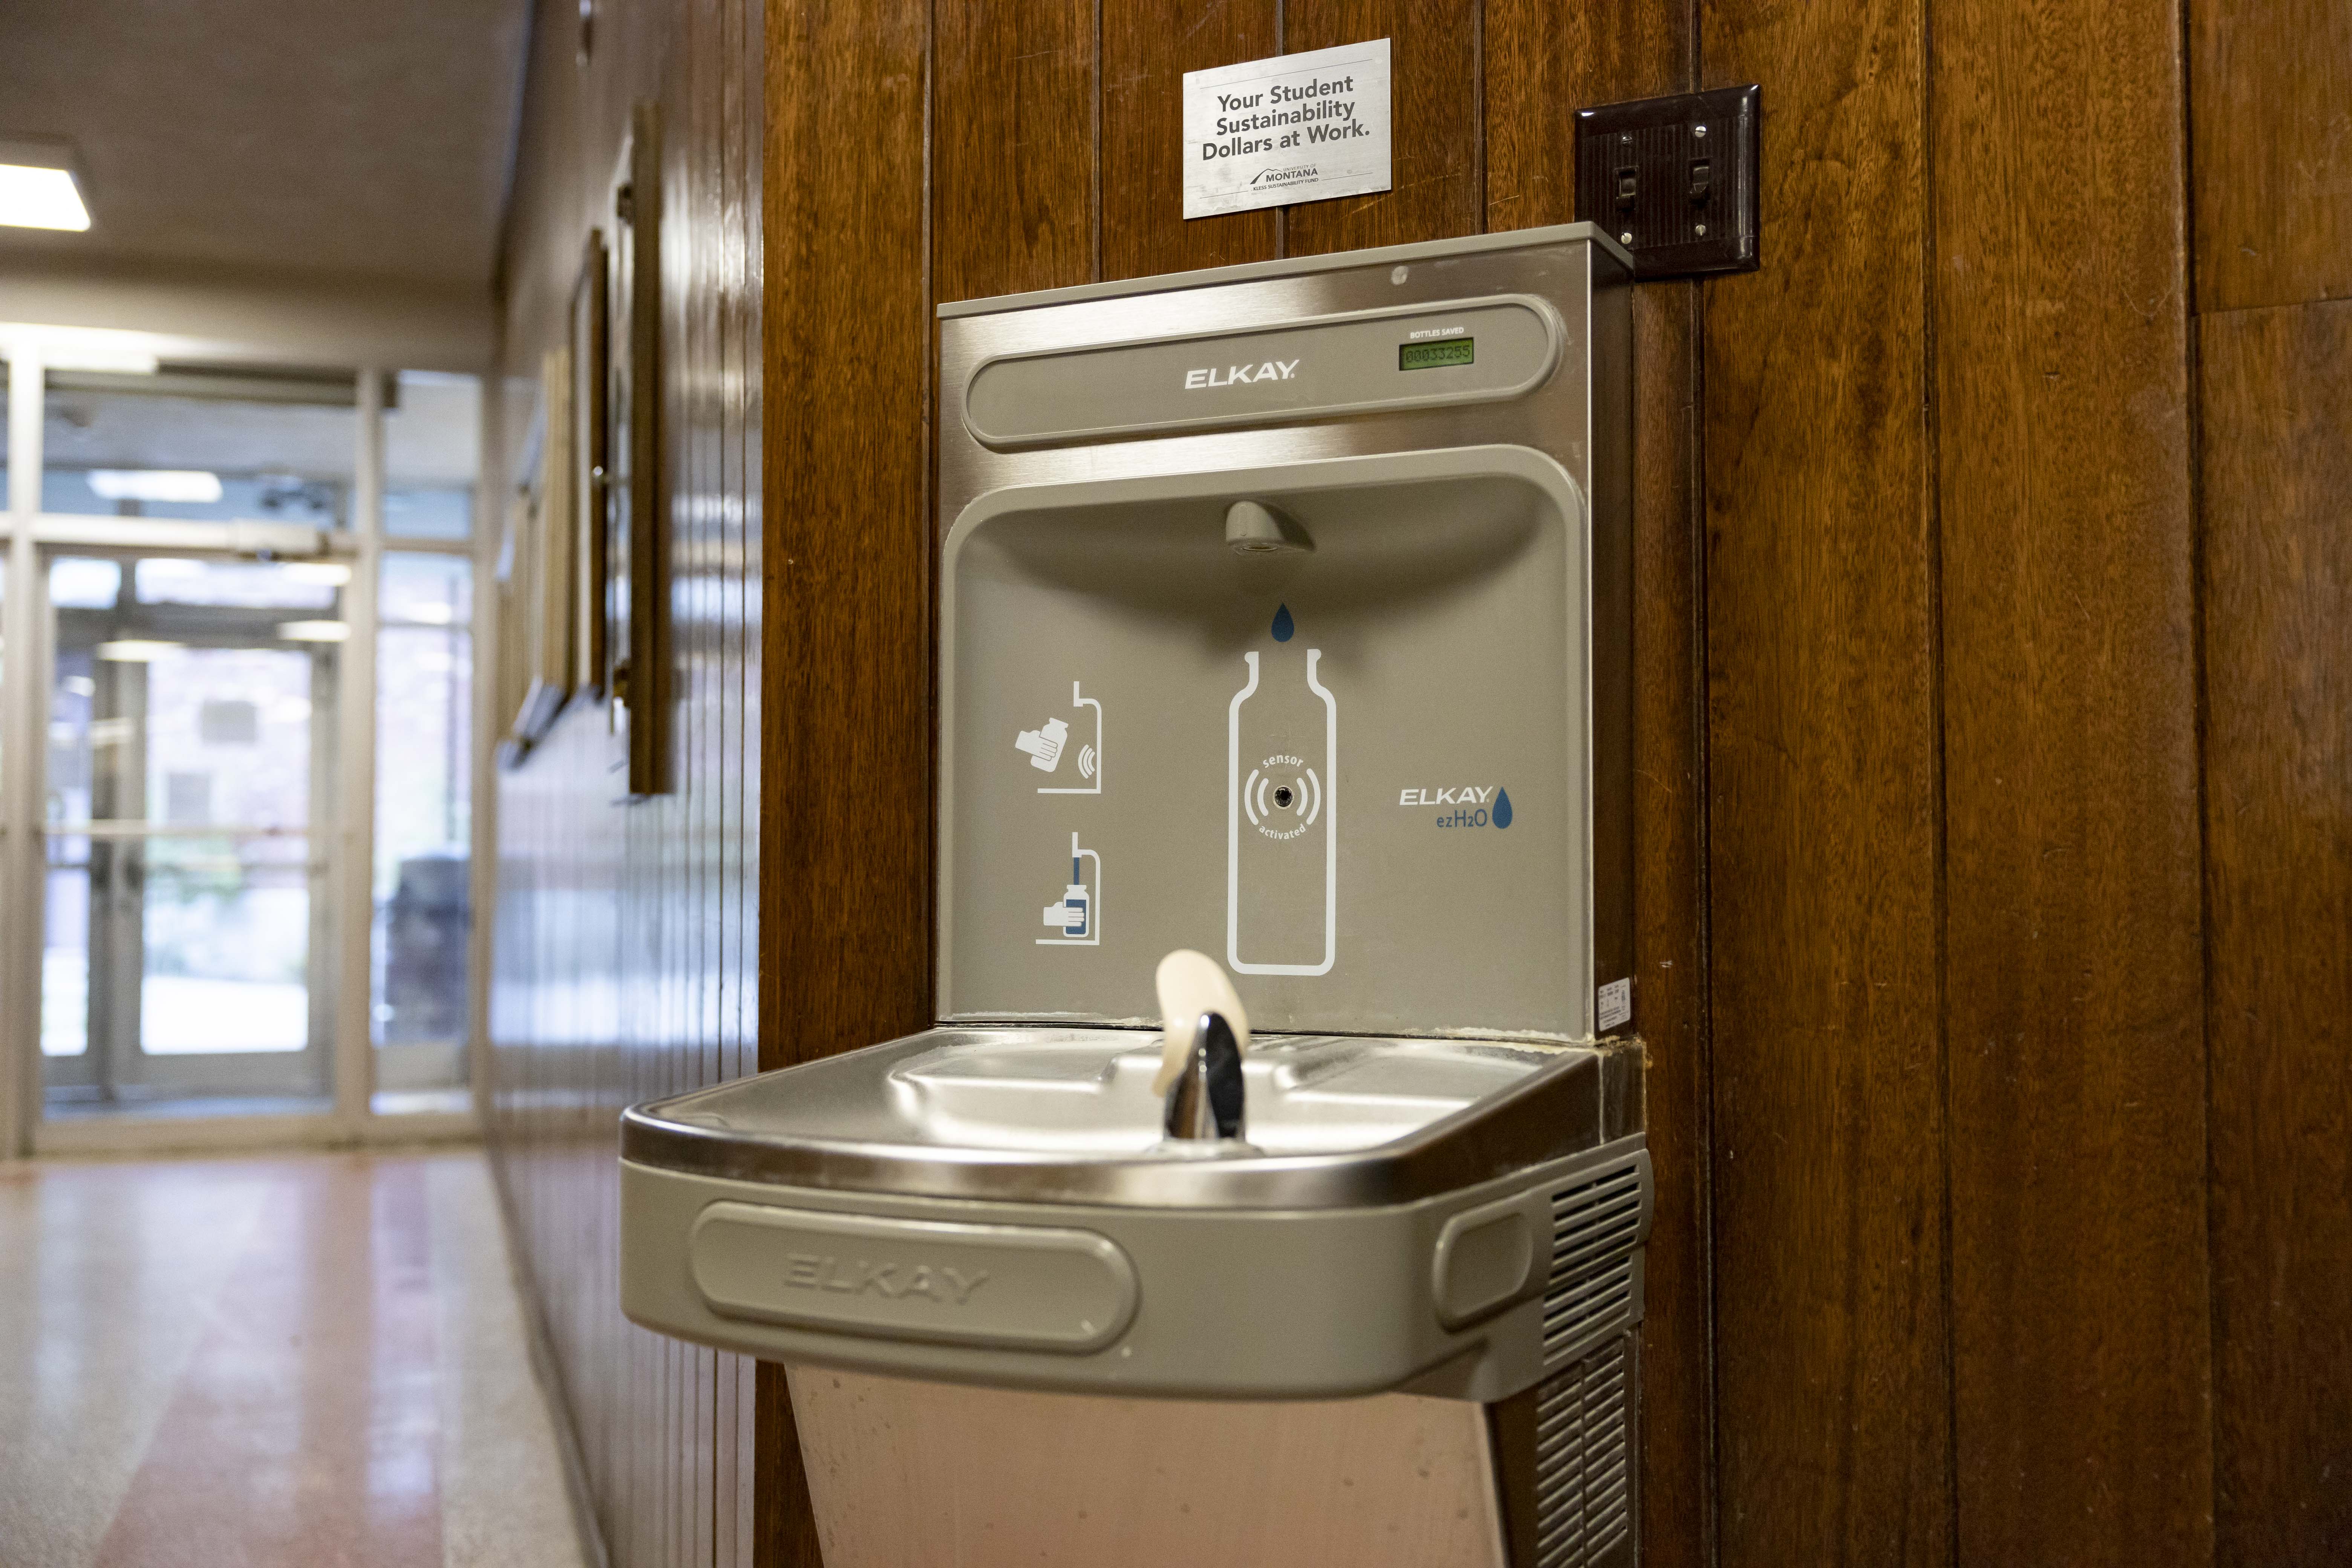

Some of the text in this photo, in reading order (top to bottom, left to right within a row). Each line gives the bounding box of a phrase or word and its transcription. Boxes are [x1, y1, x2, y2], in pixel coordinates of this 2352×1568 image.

[1217, 76, 1353, 112] Your Student
[1217, 100, 1355, 136] Sustainability
[1203, 119, 1370, 161] Dollars at Work.
[1266, 168, 1318, 182] MONTANA
[1268, 180, 1304, 189] SUSTAINABILITY
[1410, 327, 1464, 339] BOTTLES SAVED
[1185, 359, 1300, 389] ELKAY
[1263, 755, 1303, 768] sensor
[1399, 786, 1493, 805] ELKAY
[1259, 823, 1306, 840] activated
[784, 1253, 991, 1305] ELKAY
